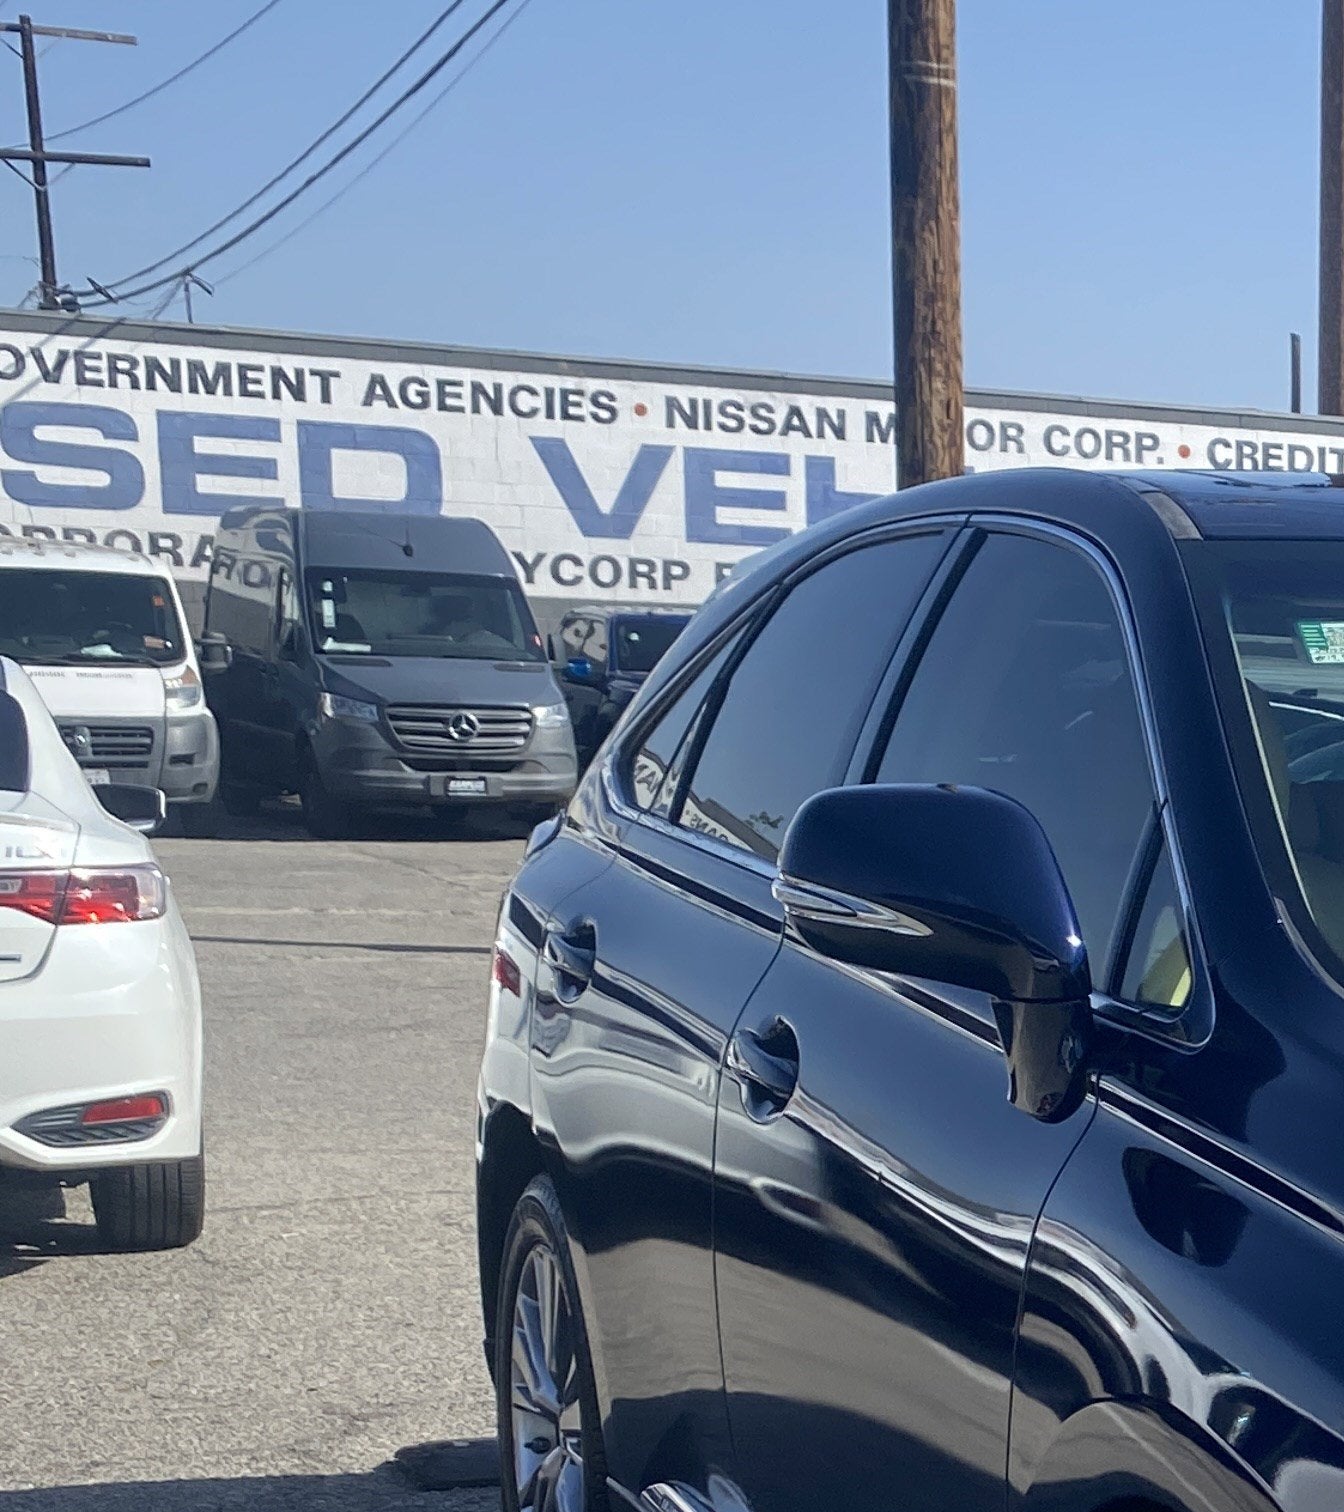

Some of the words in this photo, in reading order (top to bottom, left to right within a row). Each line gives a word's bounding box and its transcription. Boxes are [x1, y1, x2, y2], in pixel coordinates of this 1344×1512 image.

[0, 400, 443, 517] SED
[361, 373, 618, 424] AGENCIES
[665, 395, 846, 440] NISSAN
[865, 411, 1025, 453] MOR
[1043, 424, 1165, 465] CORP.
[0, 523, 214, 568] ORA
